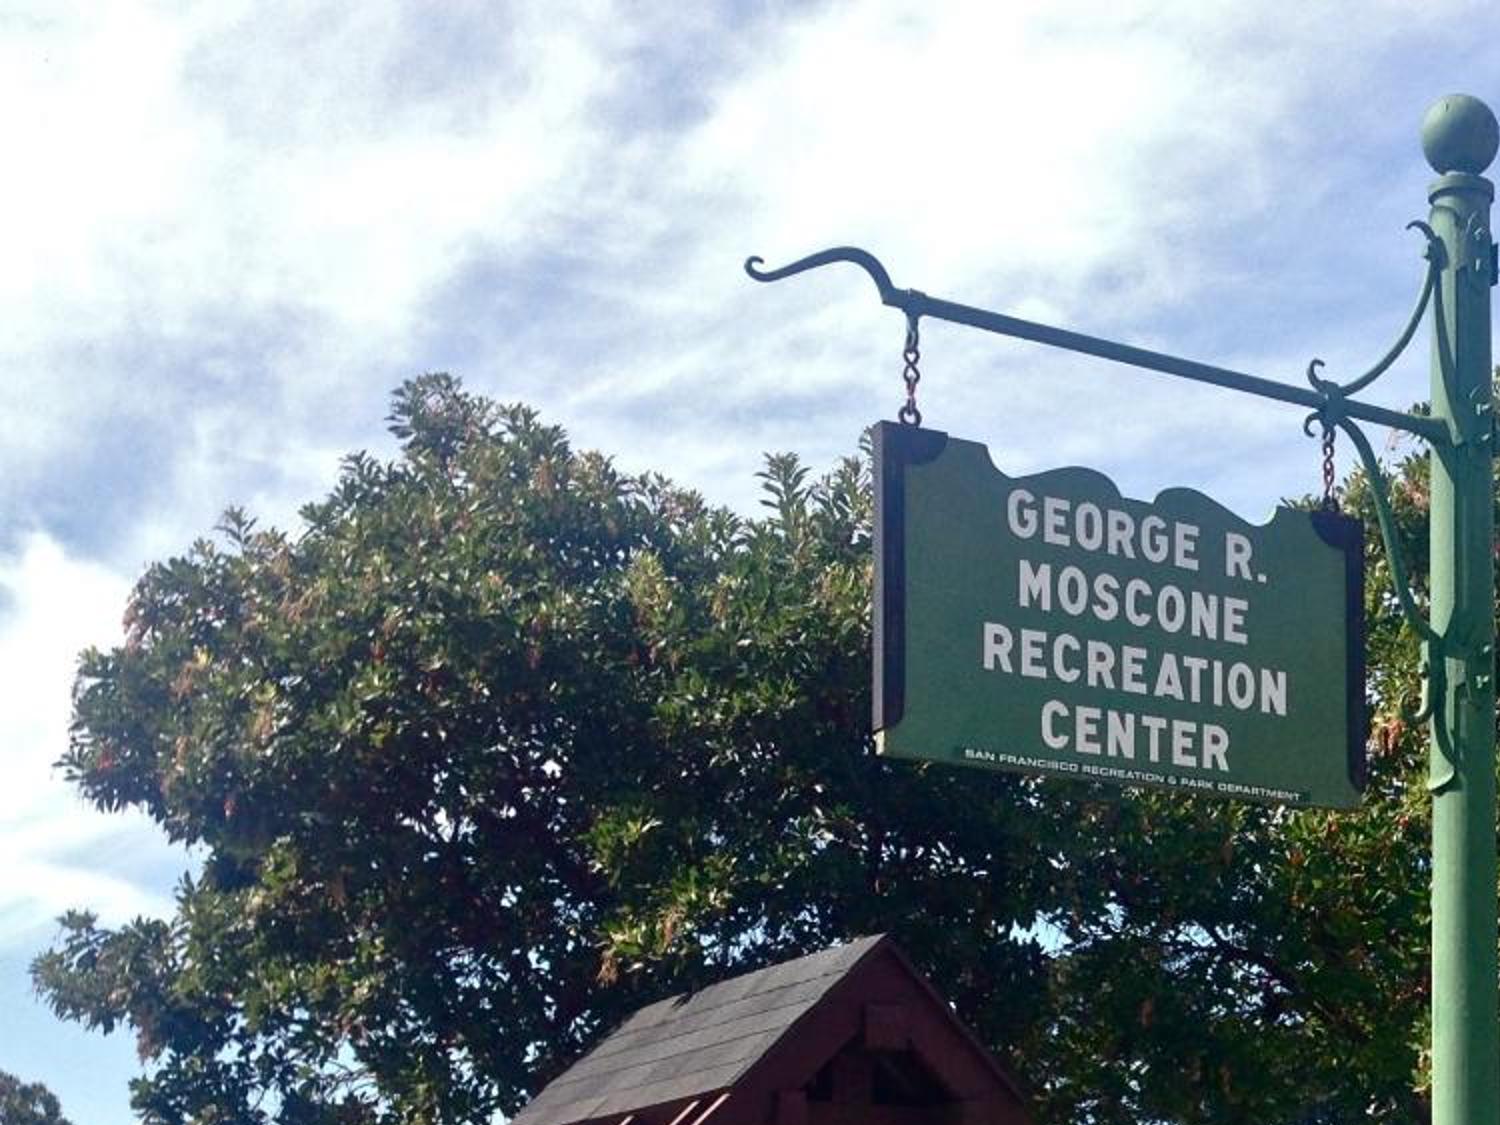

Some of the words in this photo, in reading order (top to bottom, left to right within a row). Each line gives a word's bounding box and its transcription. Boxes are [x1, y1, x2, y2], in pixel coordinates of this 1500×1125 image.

[1007, 488, 1199, 571] GEORGE
[1225, 533, 1267, 583] R.
[1018, 560, 1249, 644] MOSCONE
[983, 622, 1288, 716] RECREATION
[965, 749, 995, 761] SAN
[999, 753, 1079, 772] FRANCISCO
[1082, 764, 1164, 783] RECREATION
[1167, 775, 1177, 785] &
[1181, 777, 1215, 790] PARK
[1217, 783, 1302, 801] DEPARTMENT
[1041, 700, 1230, 771] CENTER
